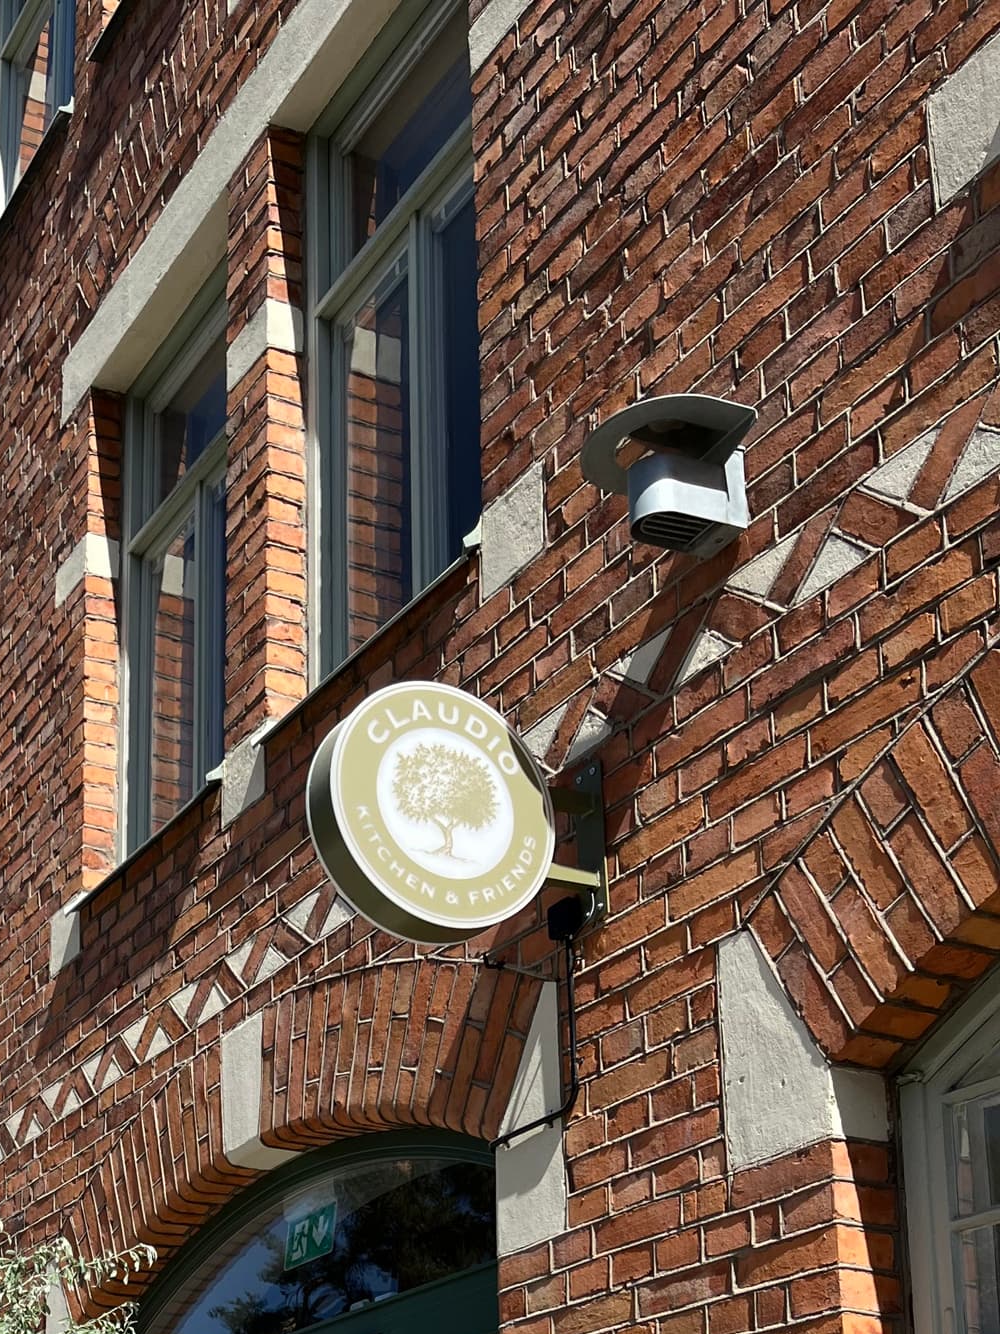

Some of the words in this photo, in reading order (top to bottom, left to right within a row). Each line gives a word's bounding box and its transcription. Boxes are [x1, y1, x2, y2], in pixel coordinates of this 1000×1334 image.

[367, 699, 519, 776] CLAUDIO
[355, 804, 436, 898] KITCHEN
[446, 892, 459, 905] &
[468, 834, 537, 906] FRIENDS
